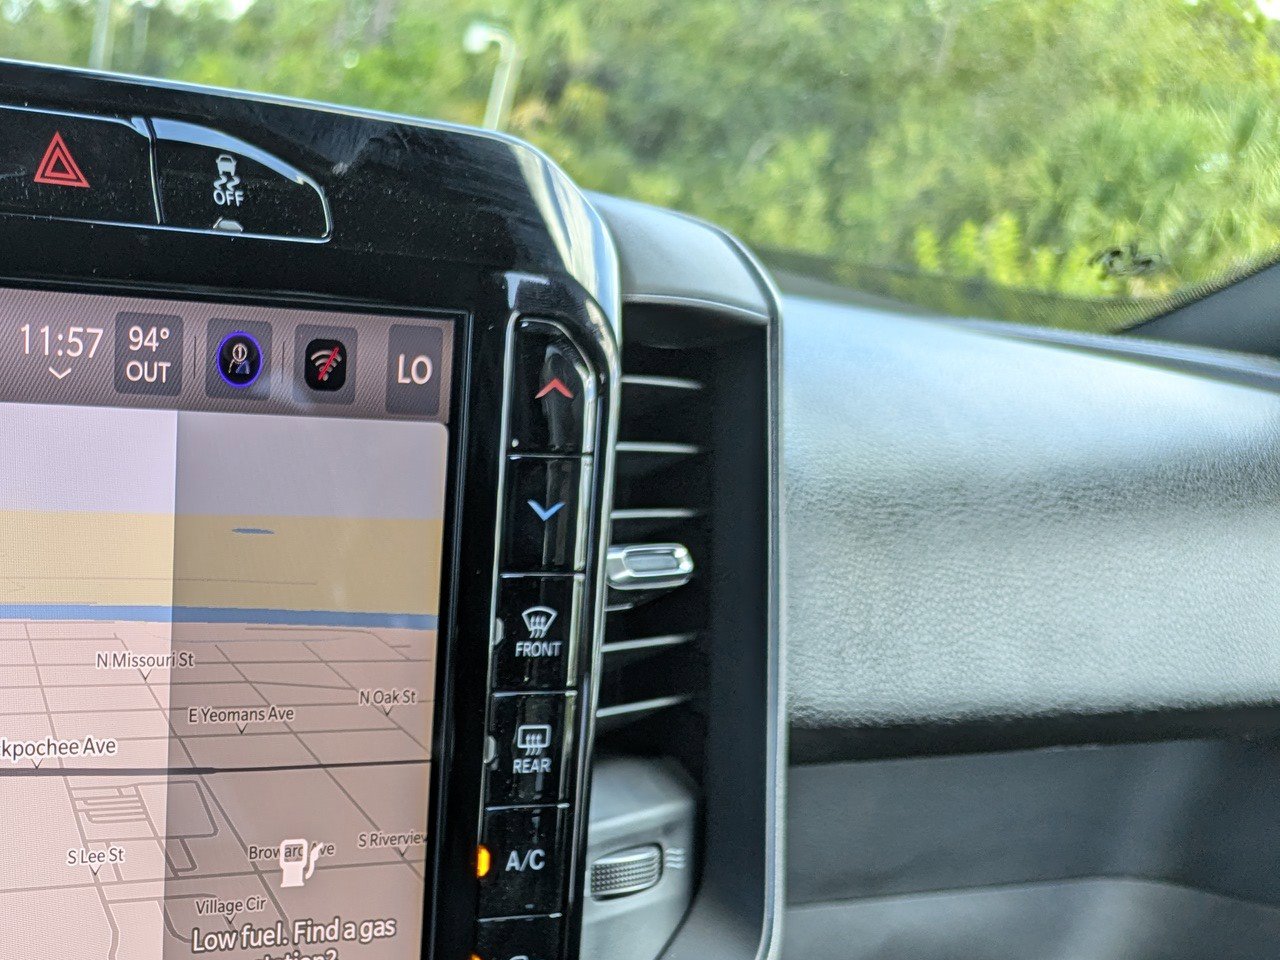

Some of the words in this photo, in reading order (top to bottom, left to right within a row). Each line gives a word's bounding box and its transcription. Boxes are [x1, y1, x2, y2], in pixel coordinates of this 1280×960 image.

[213, 189, 245, 206] OFF
[20, 323, 104, 359] 11:57
[125, 360, 171, 384] OUT
[397, 353, 434, 385] LO
[515, 641, 562, 658] FRONT
[97, 653, 108, 668] N
[112, 652, 175, 668] Missouri
[178, 652, 194, 667] St
[360, 691, 370, 704] N
[373, 690, 400, 704] Oak
[403, 689, 416, 703] St
[189, 708, 198, 722] E
[201, 708, 265, 722] Yeomans
[269, 706, 294, 720] Ave
[83, 737, 116, 754] Ave
[513, 758, 551, 774] REAR
[358, 833, 367, 847] S
[68, 851, 78, 864] S
[80, 849, 105, 864] Lee
[108, 848, 124, 862] St
[505, 848, 546, 872] A/C
[196, 898, 244, 916] Village
[247, 897, 266, 912] Cir
[192, 931, 237, 952] Low
[241, 923, 289, 949] fuel.
[293, 917, 339, 943] Find
[344, 924, 356, 939] a
[360, 918, 396, 944] gas
